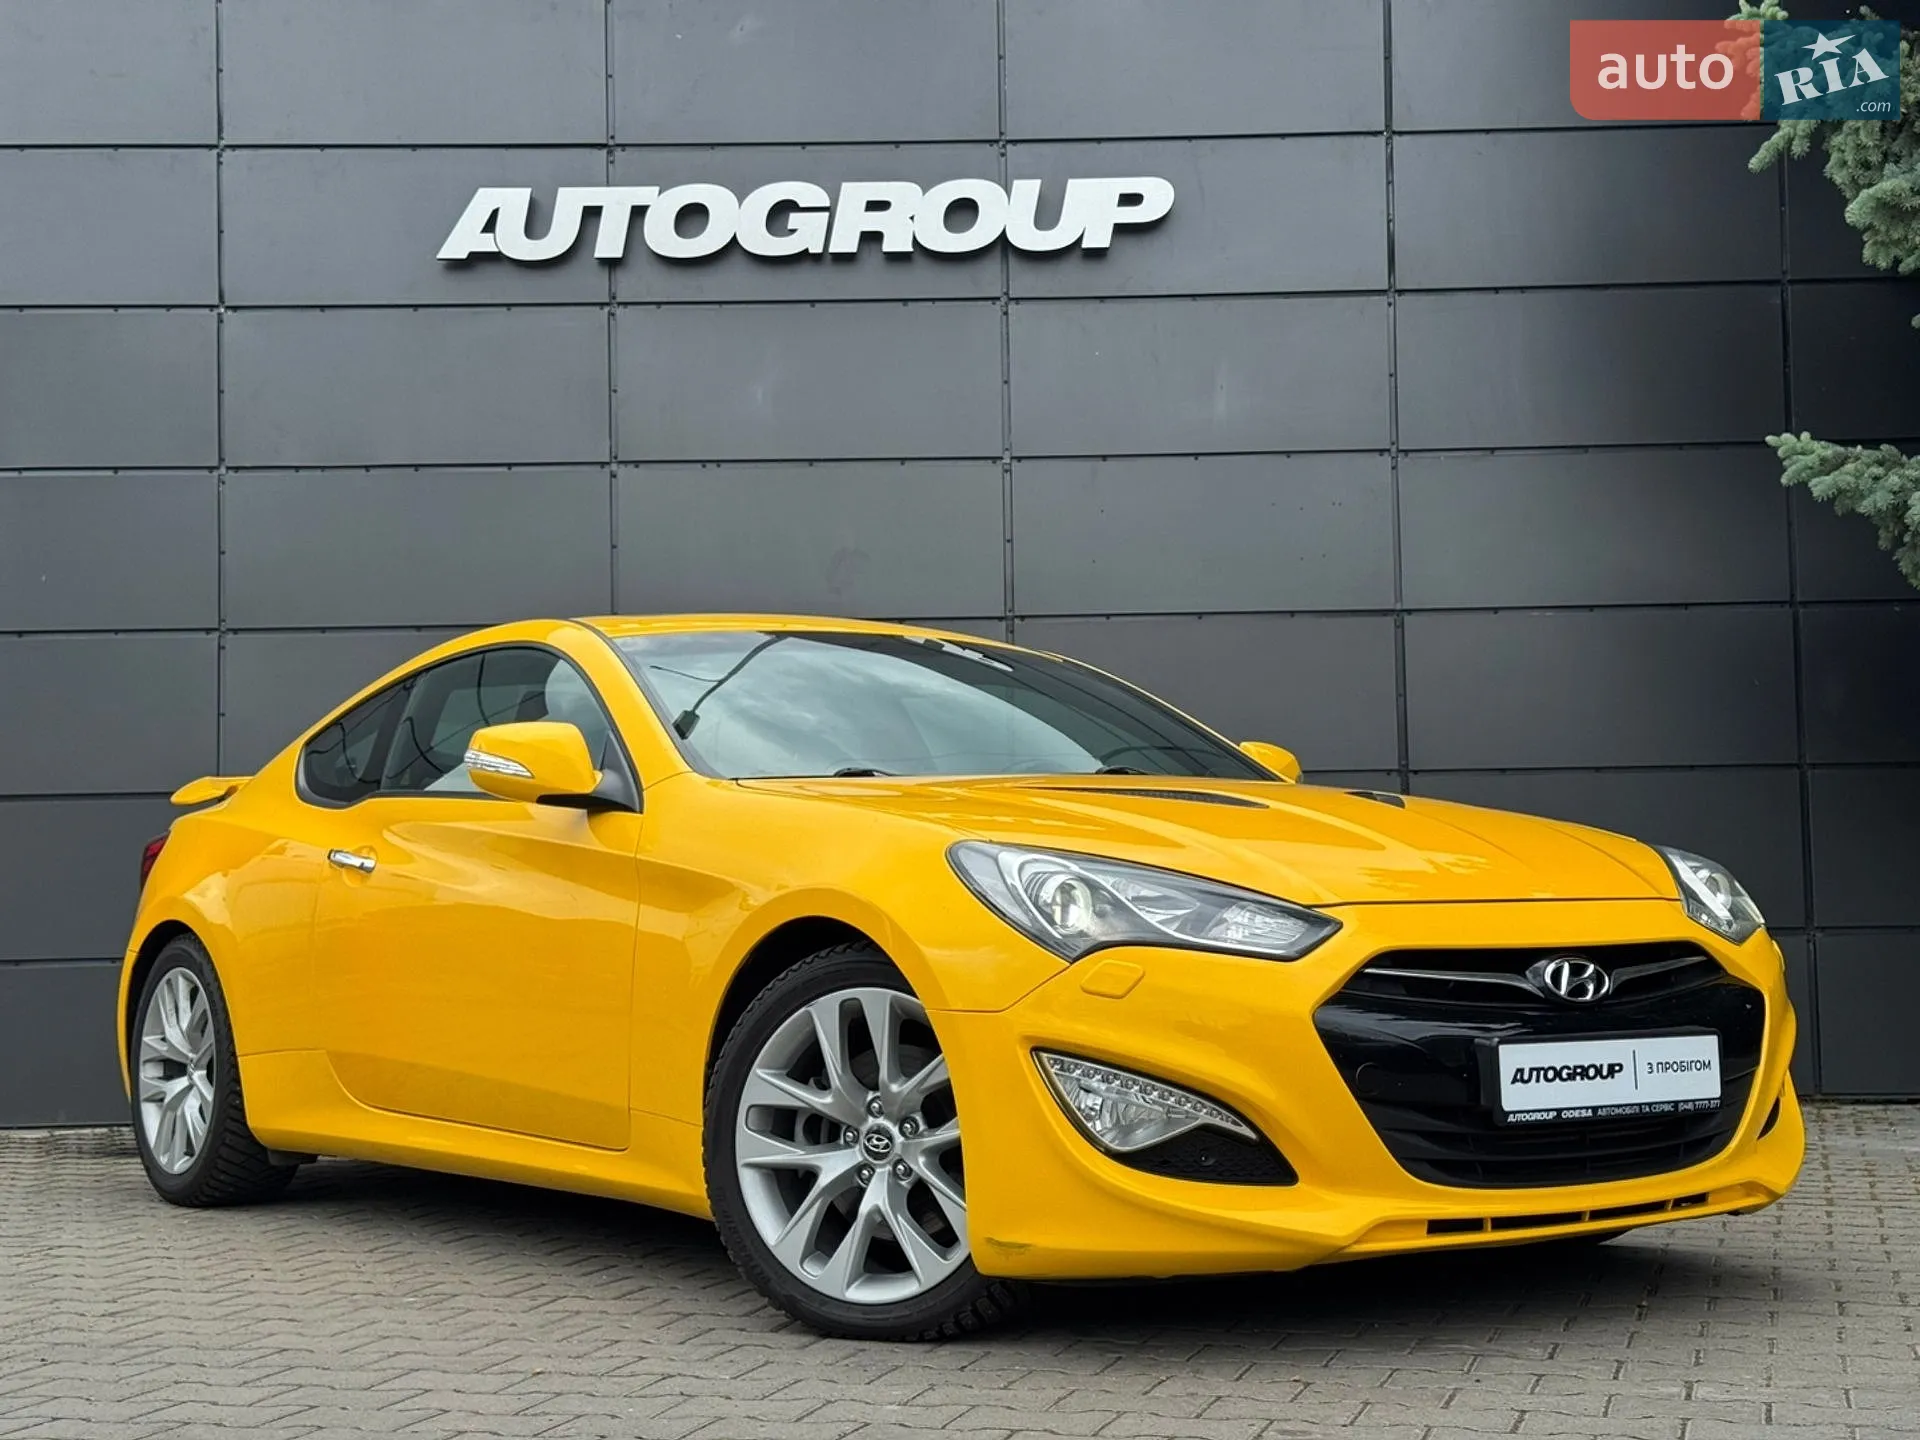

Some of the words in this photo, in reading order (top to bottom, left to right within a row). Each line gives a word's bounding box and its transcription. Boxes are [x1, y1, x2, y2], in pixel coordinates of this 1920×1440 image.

[436, 176, 1176, 262] AUTOGROUP
[1510, 1062, 1624, 1085] AUTOGROUP
[1656, 1059, 1712, 1074] ПРОБІГОМ
[1507, 1111, 1557, 1122] AUTOGROUP
[1561, 1108, 1593, 1119] ODESA
